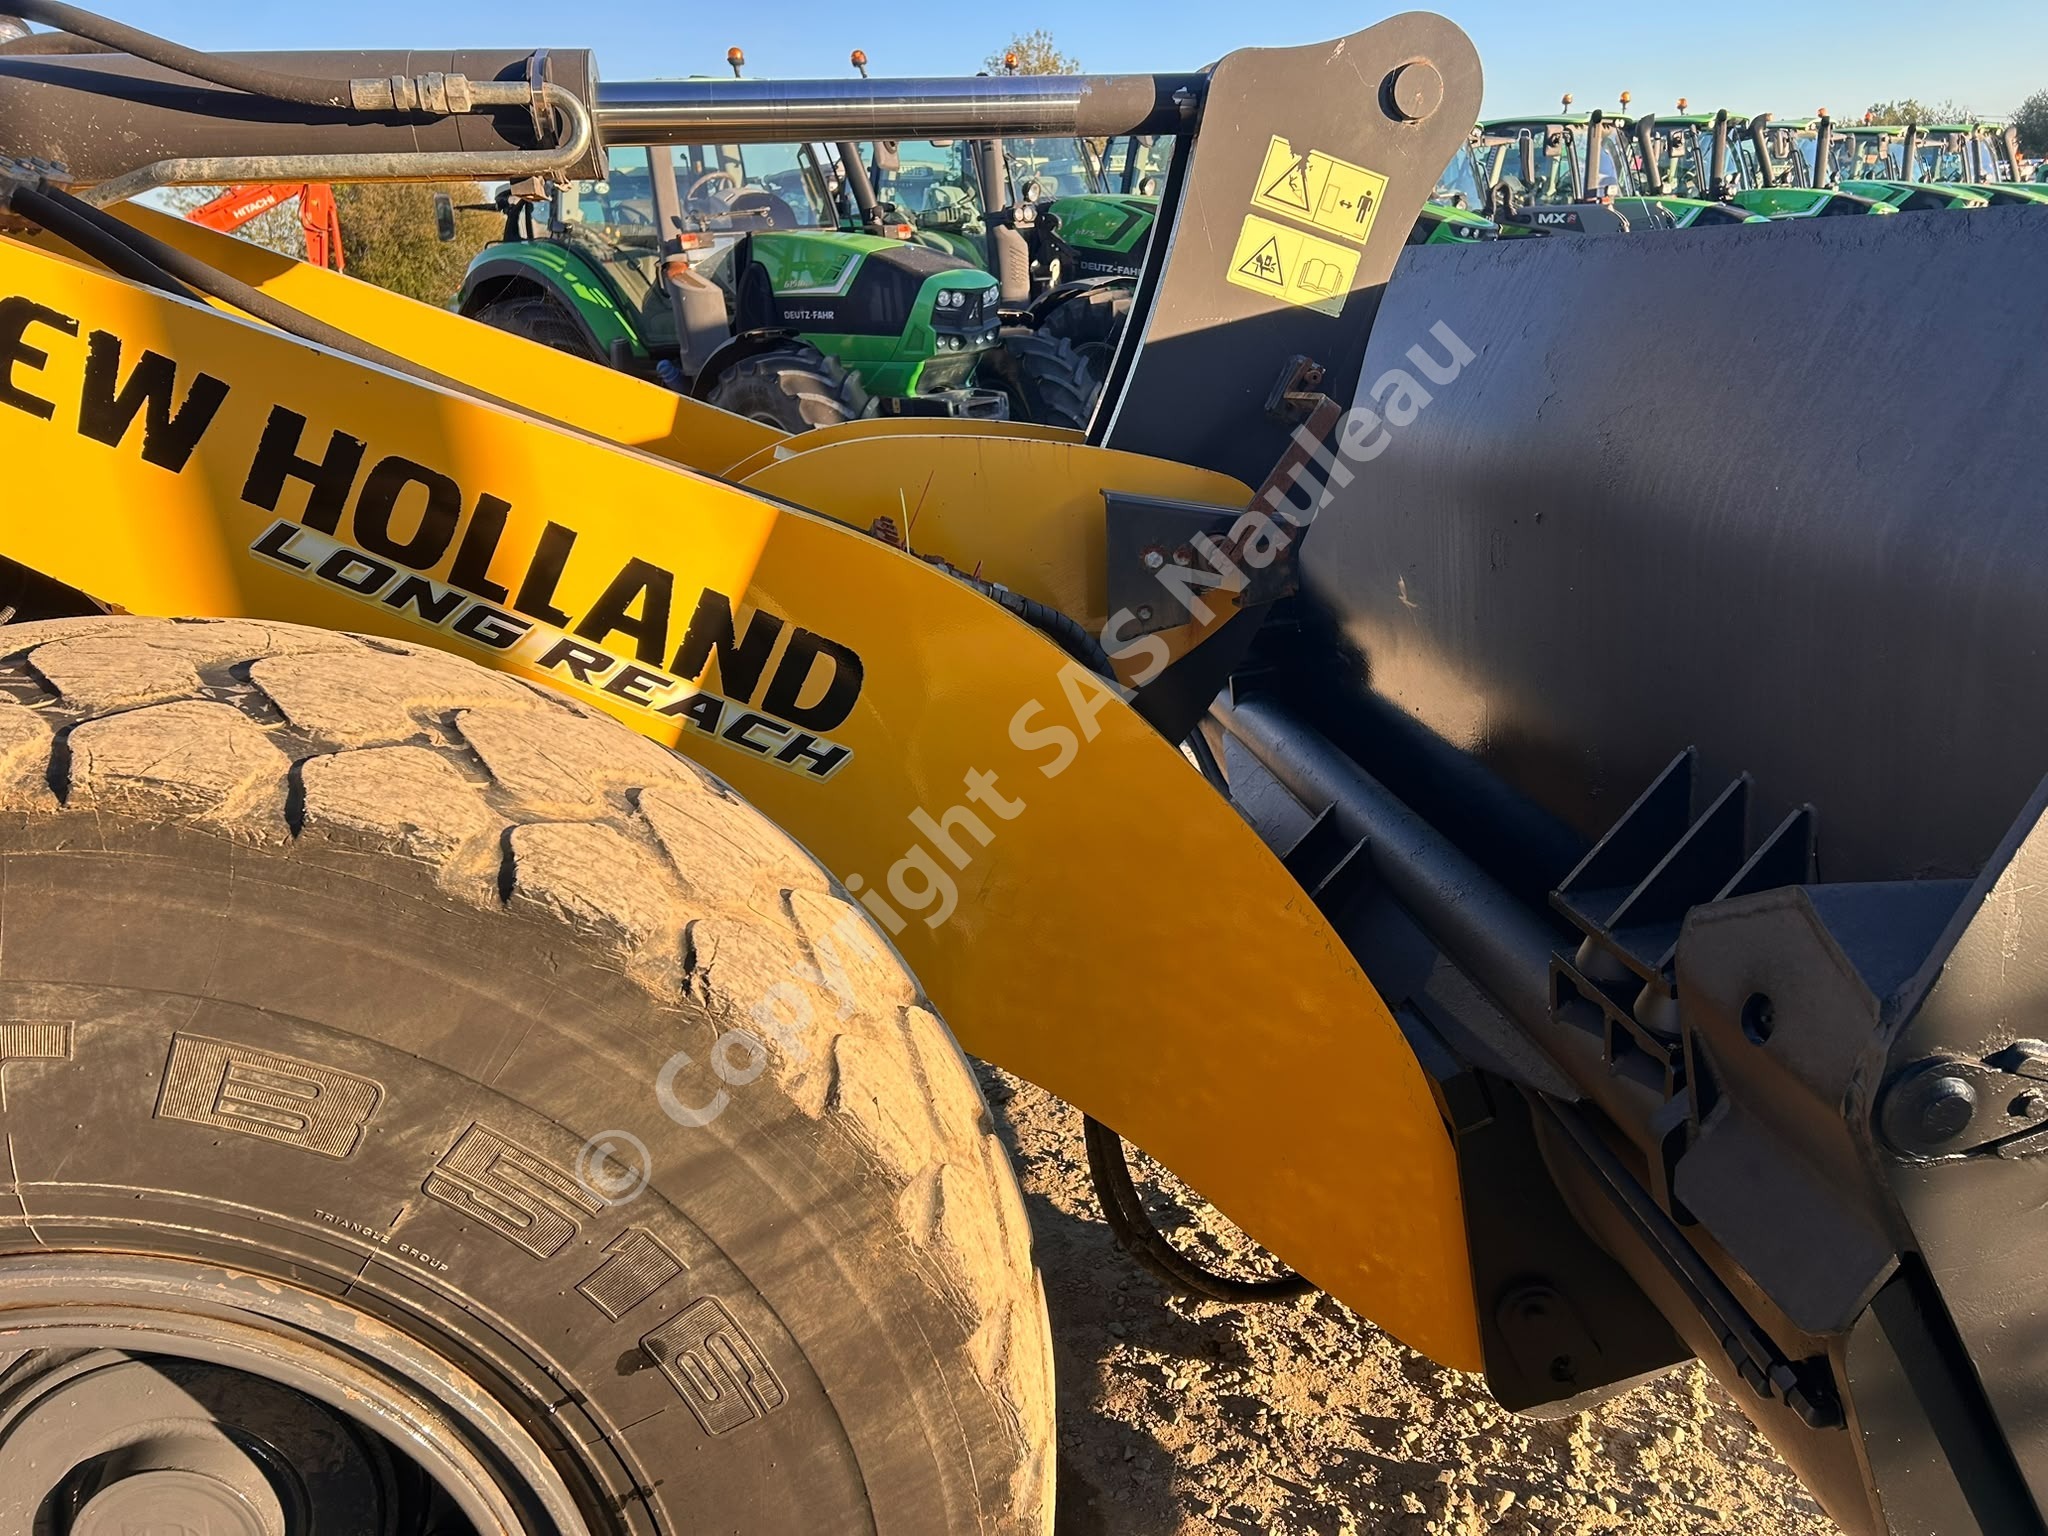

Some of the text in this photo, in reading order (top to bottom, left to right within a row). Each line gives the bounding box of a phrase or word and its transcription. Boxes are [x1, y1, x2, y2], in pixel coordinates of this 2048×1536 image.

[233, 195, 276, 218] HITACHI
[1538, 213, 1566, 223] MX
[783, 310, 834, 320] DEUTZ-FAHR
[240, 404, 865, 733] HOLLAND
[249, 520, 853, 777] LONG REACH
[313, 1208, 448, 1272] TRIANGLE GROUP
